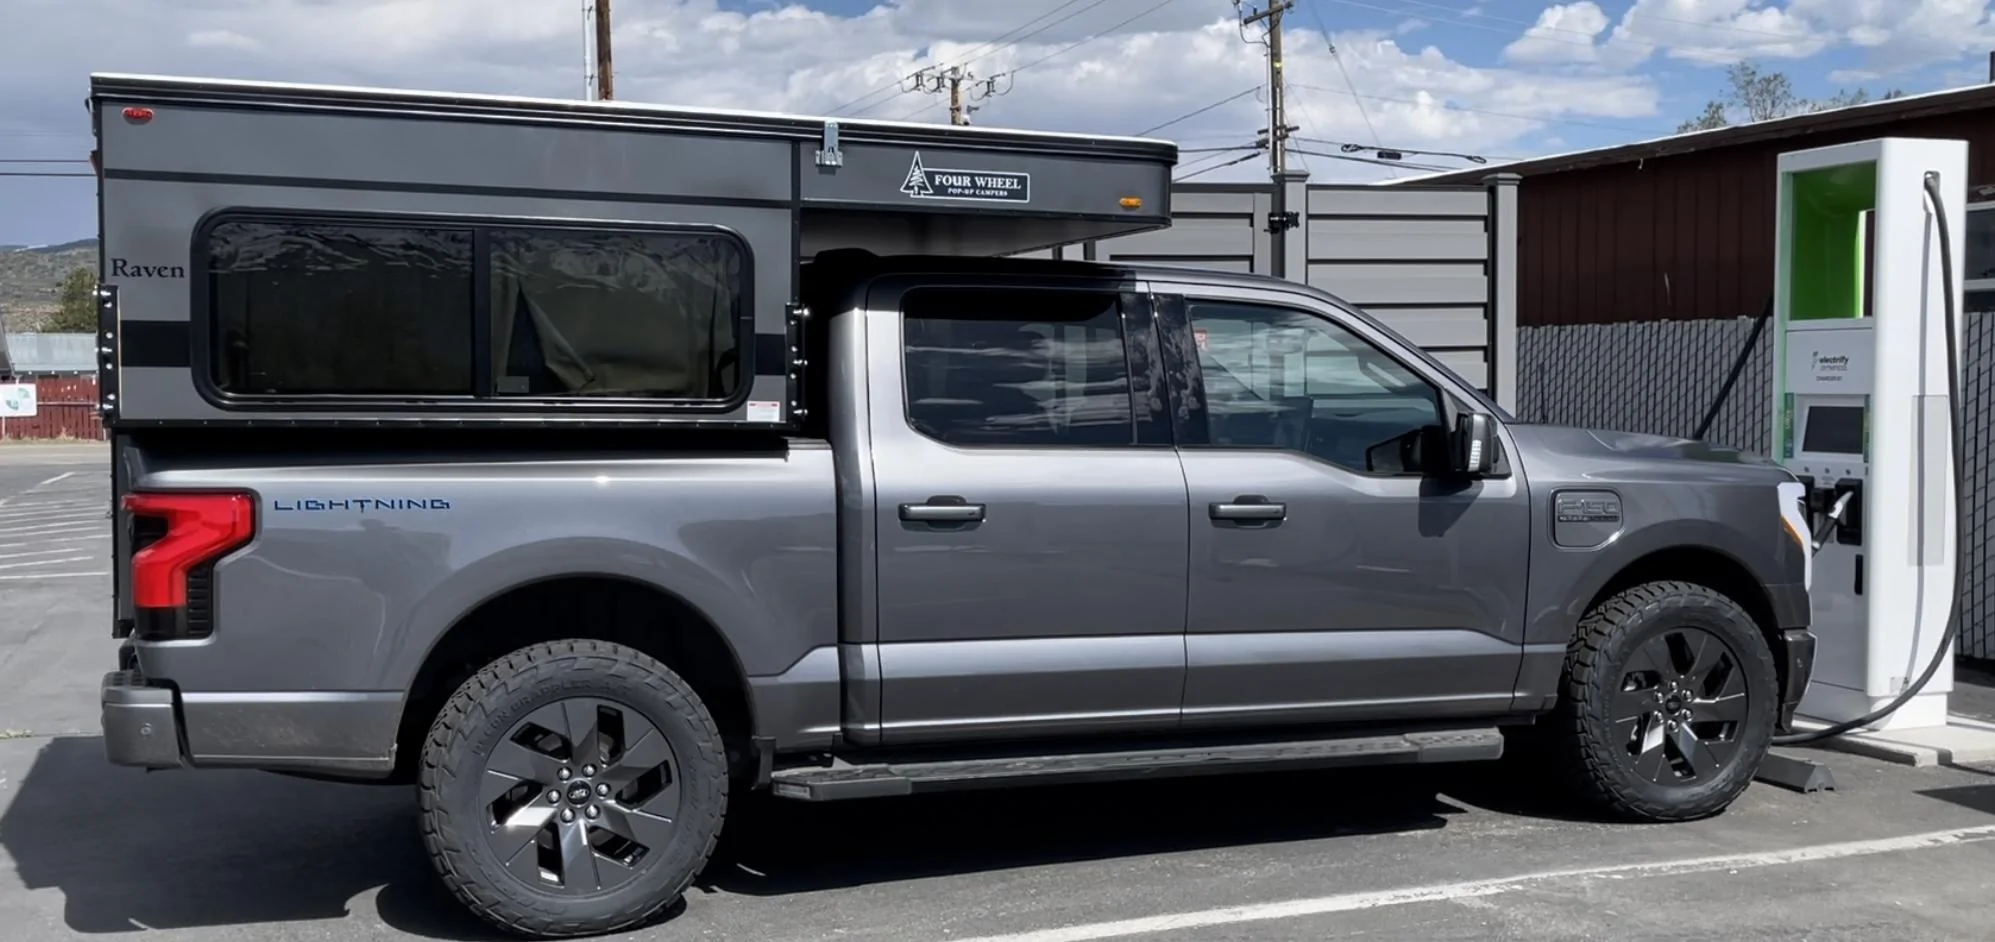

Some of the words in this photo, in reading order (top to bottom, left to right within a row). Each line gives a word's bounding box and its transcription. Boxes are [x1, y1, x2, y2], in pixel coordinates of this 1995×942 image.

[934, 174, 971, 187] FOUR
[974, 176, 1021, 189] WHEEL
[948, 187, 974, 195] POP-UP
[975, 188, 1008, 197] CAMPERS
[111, 258, 185, 278] Raven
[274, 499, 451, 513] LIGHTNING
